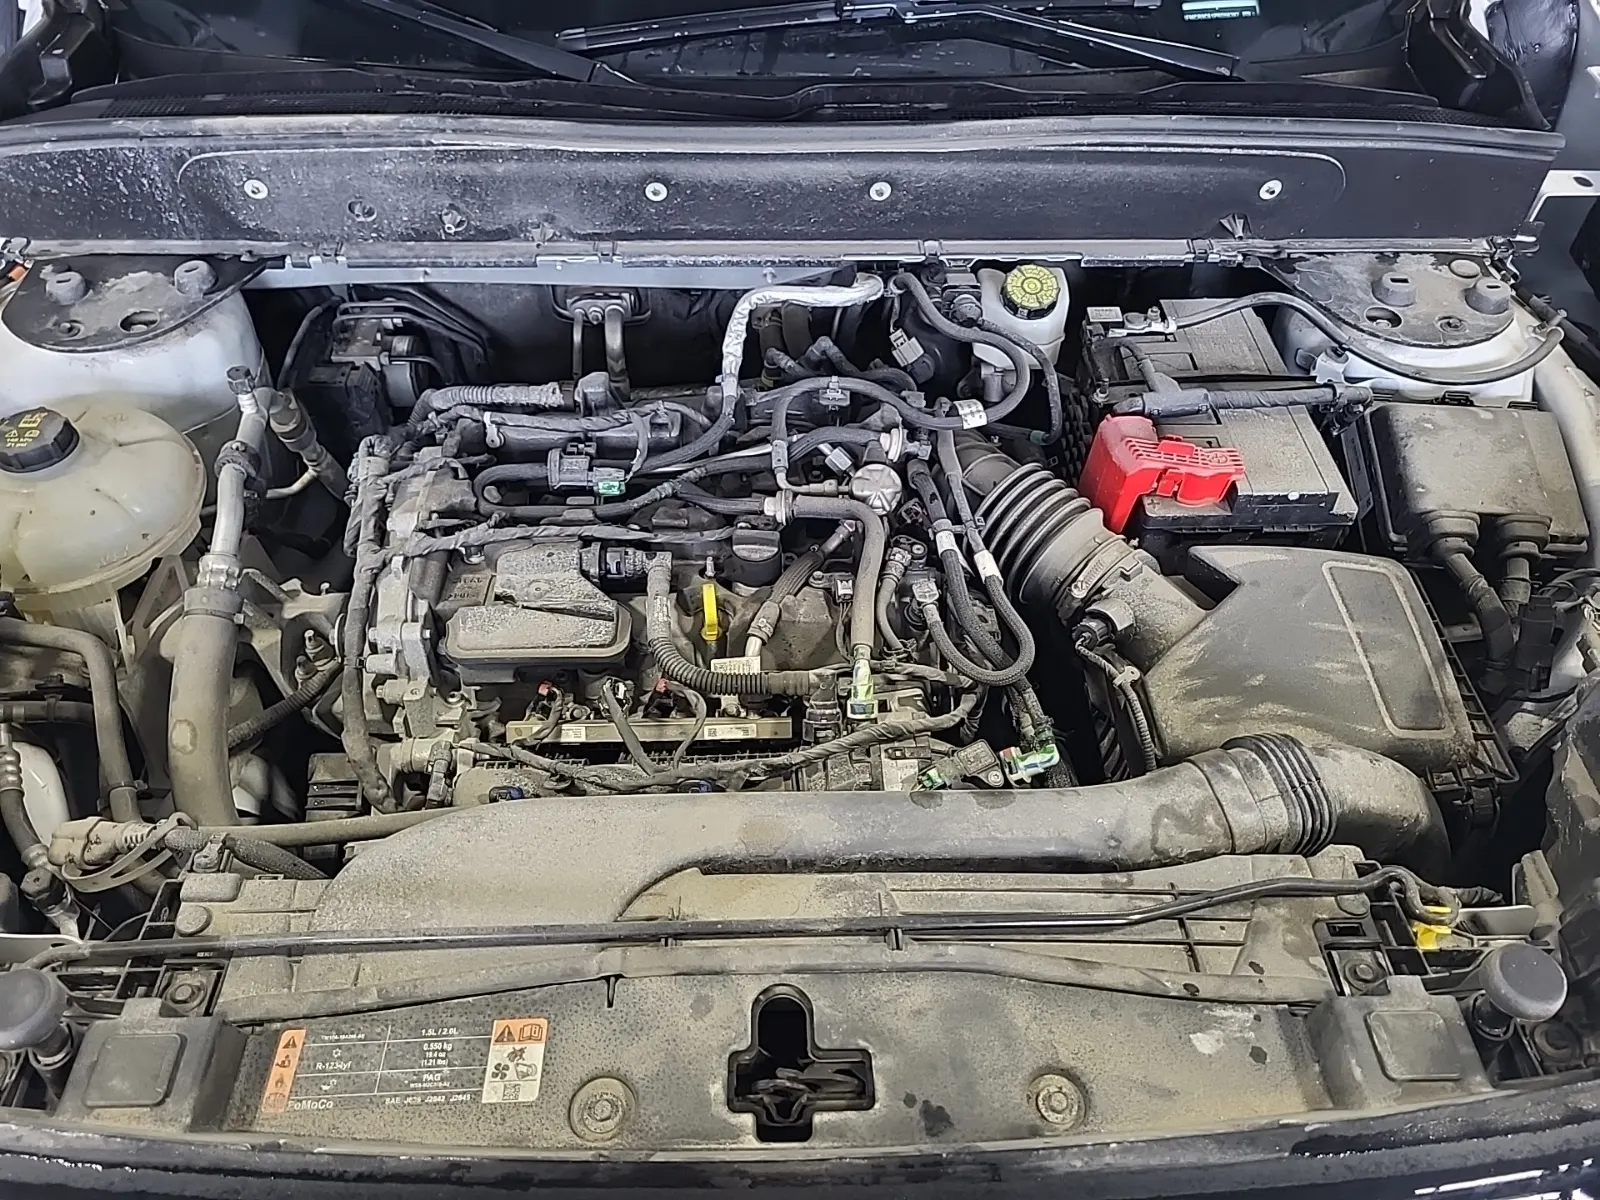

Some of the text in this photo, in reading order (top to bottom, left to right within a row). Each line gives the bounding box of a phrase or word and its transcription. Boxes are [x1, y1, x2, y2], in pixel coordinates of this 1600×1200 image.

[421, 1028, 437, 1037] 1.5L
[442, 1027, 459, 1035] 2.0L
[423, 1041, 453, 1052] 0.550 kg
[422, 1073, 442, 1082] PAG
[288, 1099, 334, 1110] FoMoCo
[384, 1096, 401, 1105] SAE
